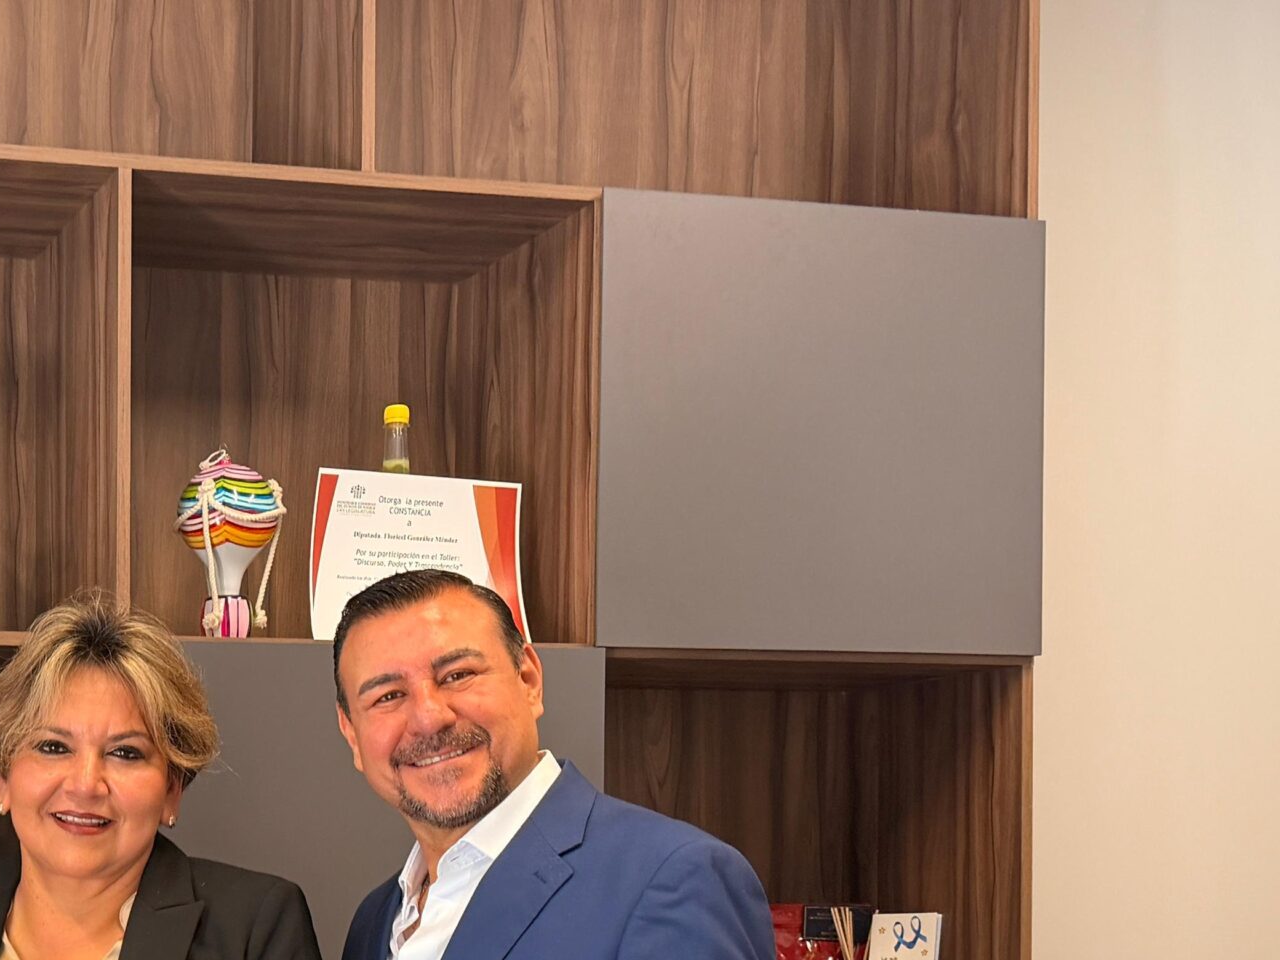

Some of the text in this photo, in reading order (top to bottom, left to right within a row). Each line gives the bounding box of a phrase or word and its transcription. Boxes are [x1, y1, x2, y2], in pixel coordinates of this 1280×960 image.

[379, 495, 402, 505] Otorga
[413, 499, 444, 508] presente
[389, 507, 432, 516] CONSTANCIA
[356, 548, 366, 556] Por
[377, 550, 420, 559] participación
